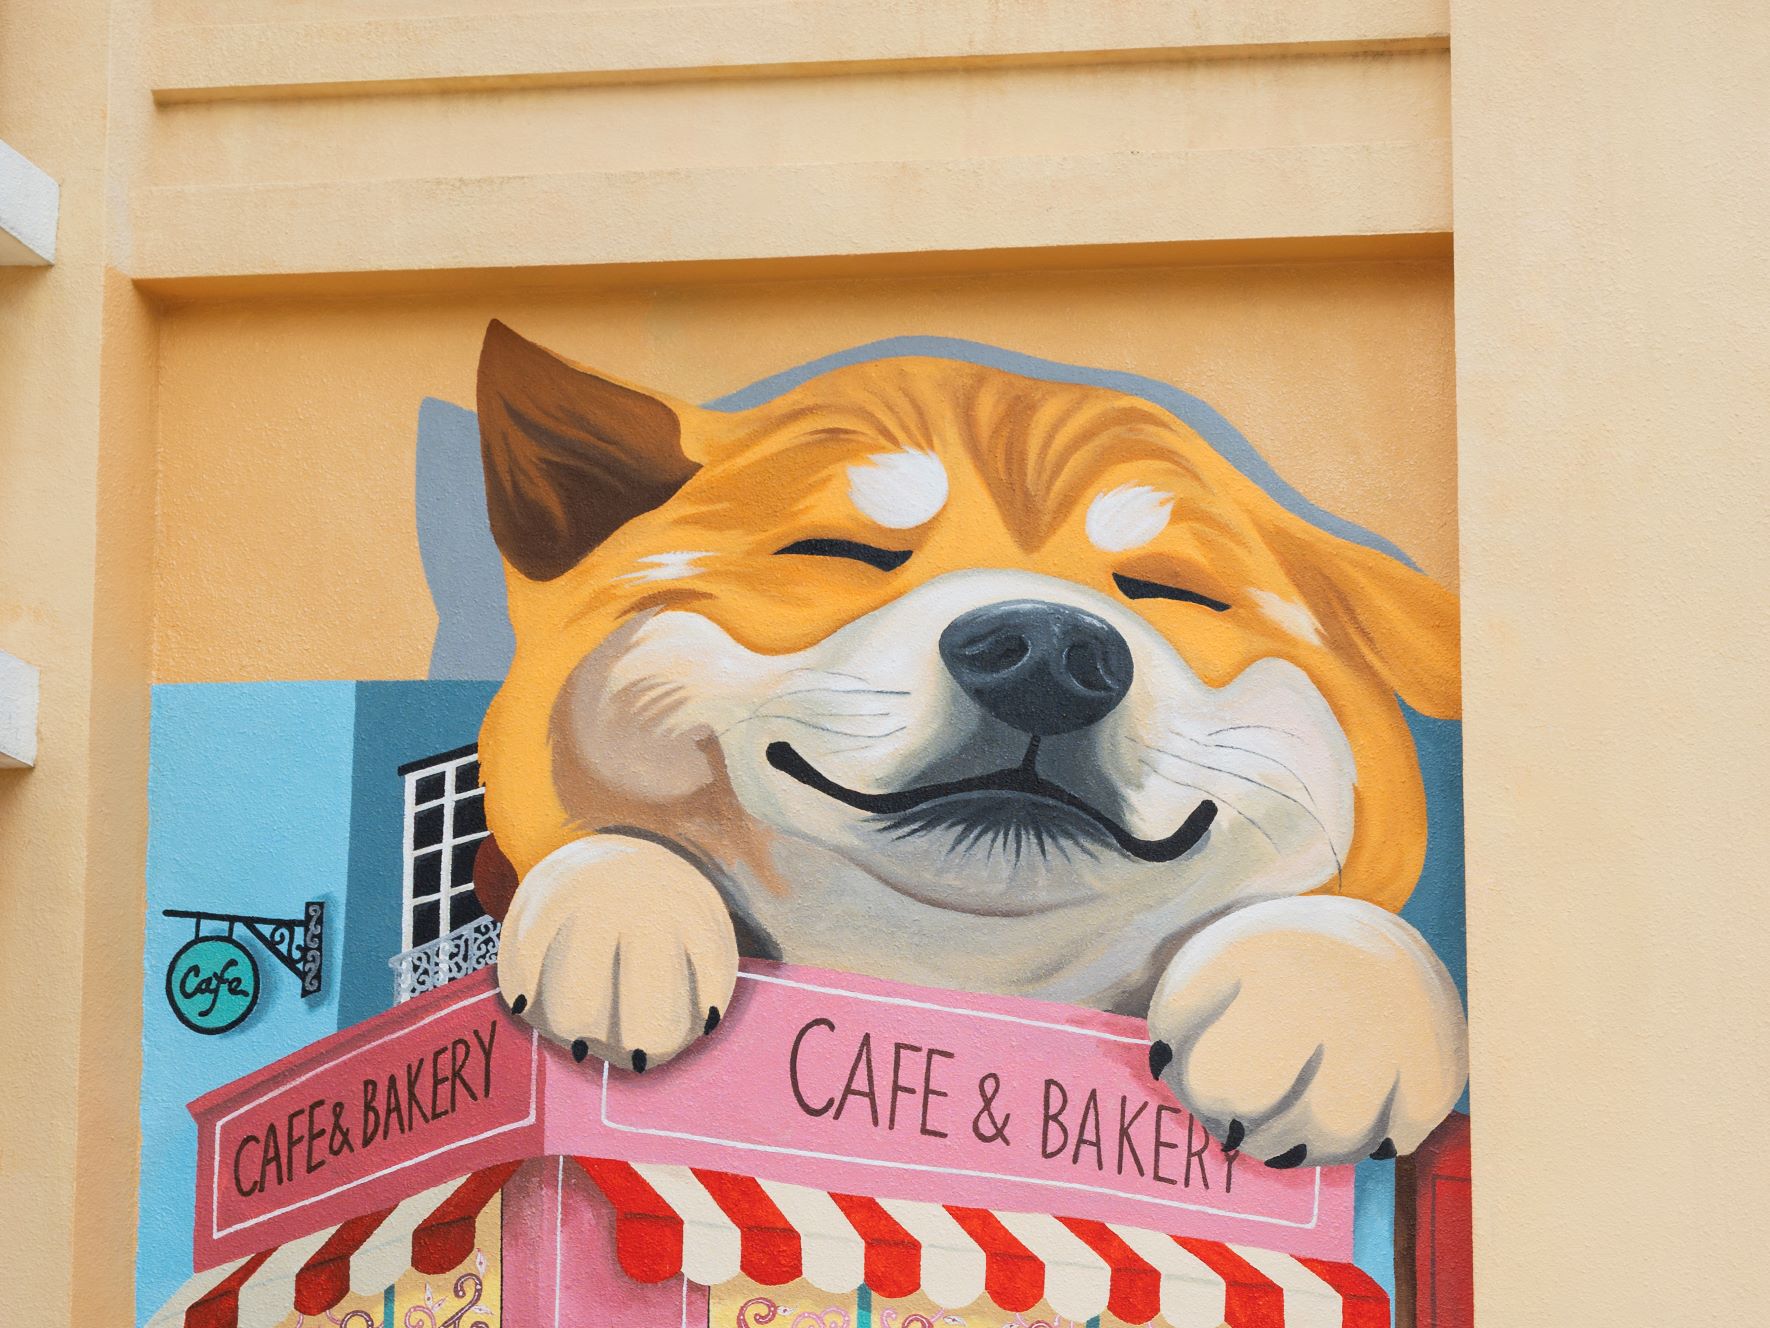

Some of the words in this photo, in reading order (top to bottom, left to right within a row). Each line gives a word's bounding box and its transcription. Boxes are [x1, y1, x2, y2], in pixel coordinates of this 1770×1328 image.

[179, 958, 250, 1017] Cafe
[361, 1020, 497, 1149] BAKERY
[789, 1017, 955, 1139] CAFE
[972, 1072, 1011, 1146] &
[1041, 1078, 1239, 1193] BAKERY
